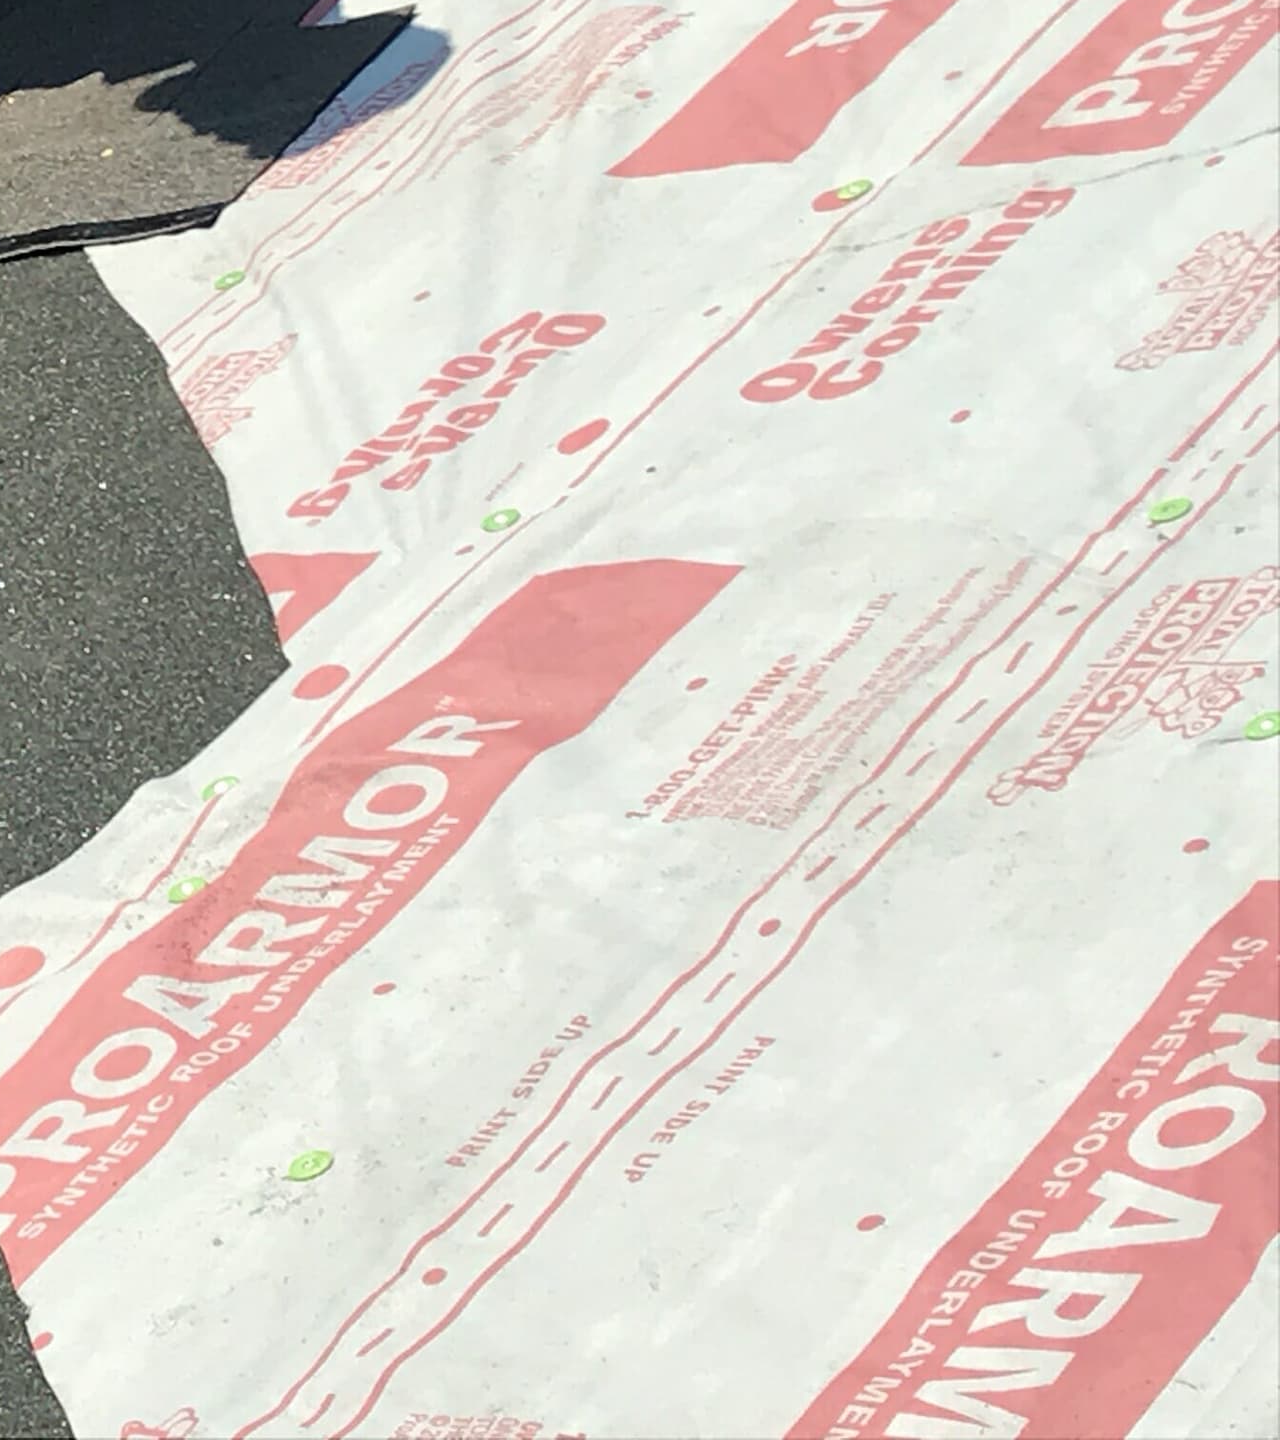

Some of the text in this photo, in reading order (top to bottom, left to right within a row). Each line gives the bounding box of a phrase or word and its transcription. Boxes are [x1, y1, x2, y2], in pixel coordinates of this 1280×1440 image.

[739, 216, 972, 404] Owens
[807, 185, 1077, 401] Corning
[285, 311, 544, 520] Corning
[380, 312, 608, 492] Owens
[1021, 582, 1230, 782] PROTECTION
[17, 811, 462, 1242] SYNTHETIC ROOF UNDERLAYMENT
[444, 1012, 593, 1168] PRINT SIDE UP
[623, 1034, 777, 1185] PRINT SIDE UP
[1115, 935, 1271, 1100] SYNTHETIC
[883, 1012, 1280, 1440] ROARM
[1041, 1110, 1130, 1200] ROOF
